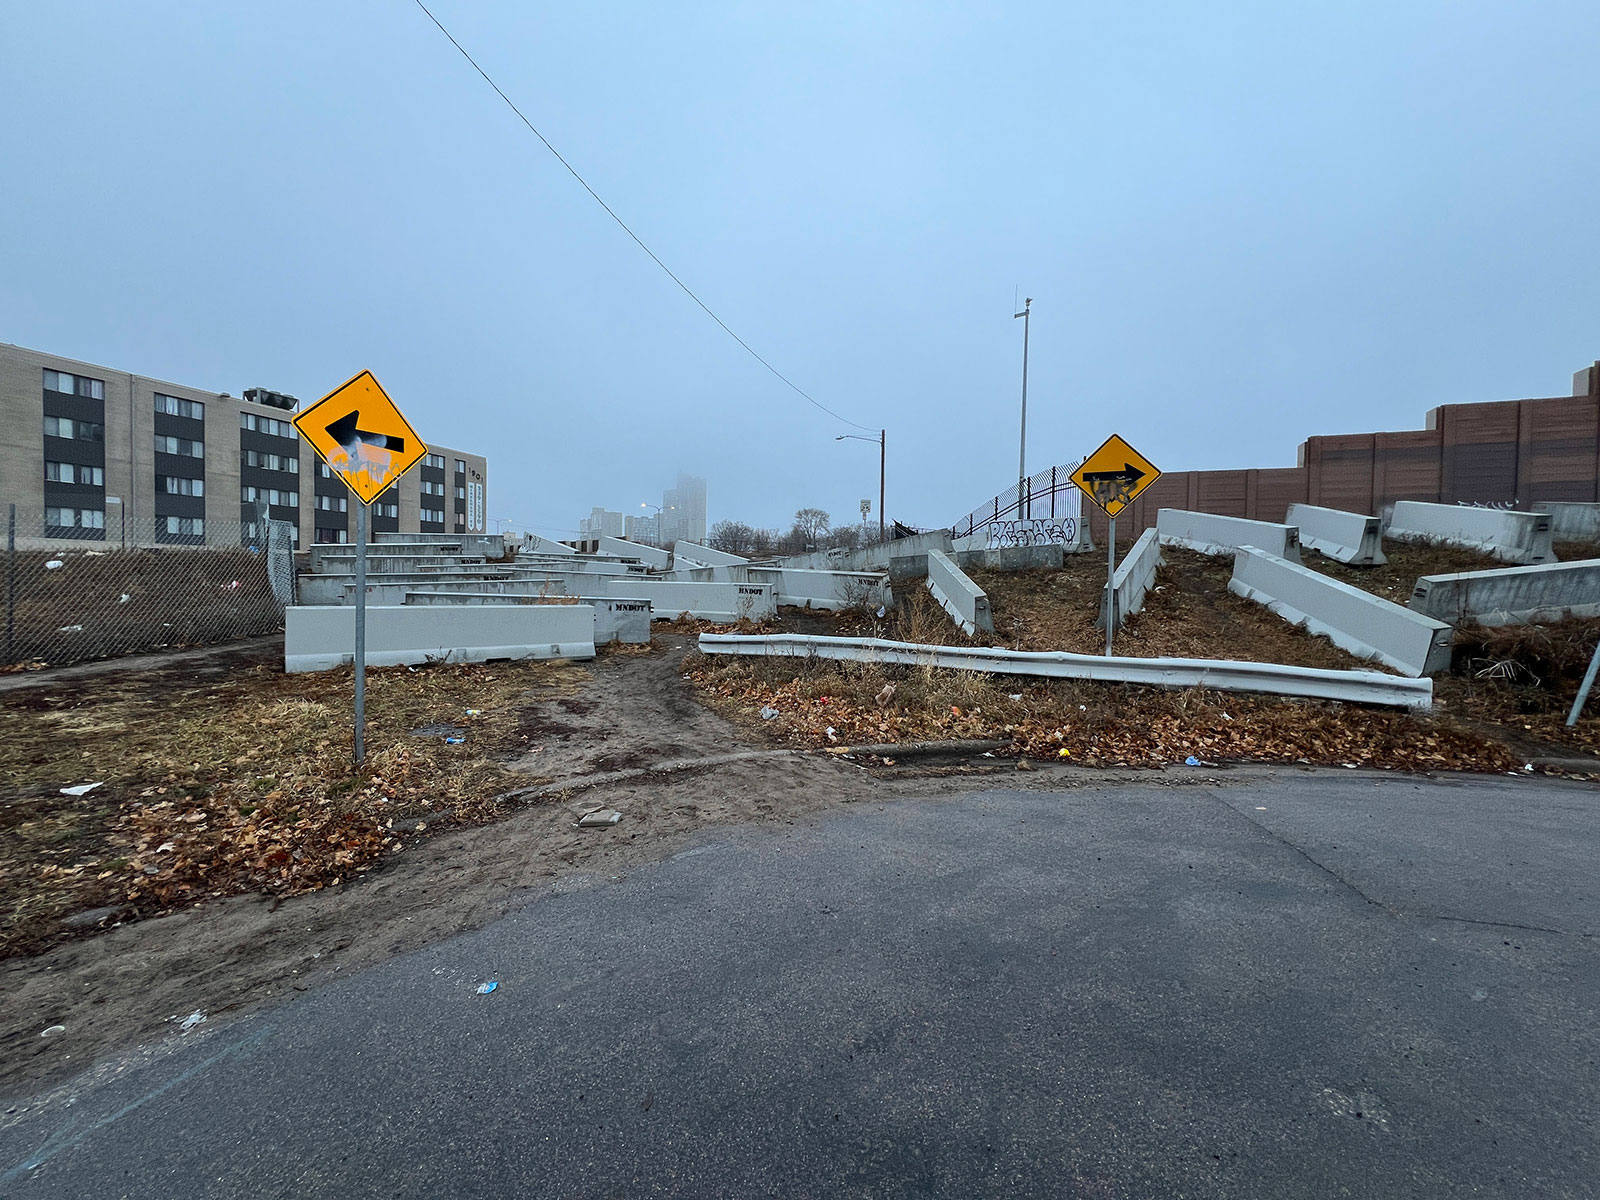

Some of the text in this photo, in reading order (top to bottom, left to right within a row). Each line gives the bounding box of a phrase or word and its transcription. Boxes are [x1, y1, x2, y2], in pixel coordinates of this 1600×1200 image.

[468, 467, 484, 483] 1901
[738, 587, 763, 596] MNDOT
[615, 603, 646, 612] MNDOT
